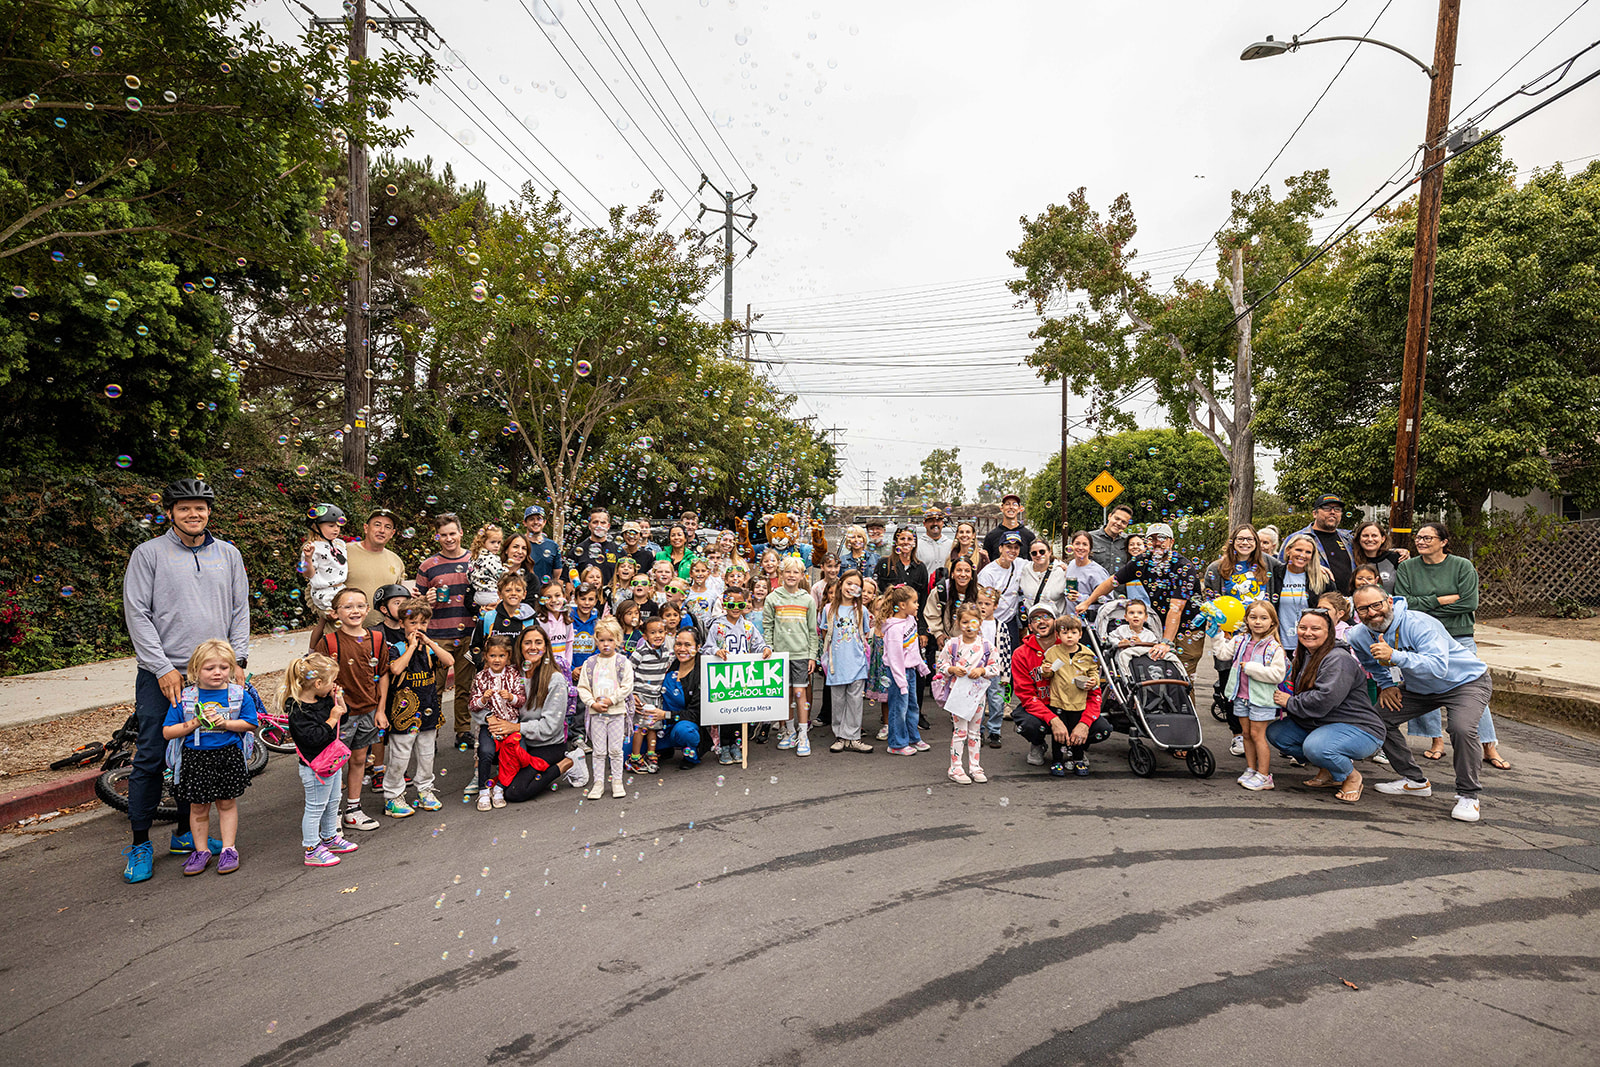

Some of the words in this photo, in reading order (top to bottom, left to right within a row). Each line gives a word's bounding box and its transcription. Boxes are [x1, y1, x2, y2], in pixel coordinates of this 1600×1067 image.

[1095, 484, 1114, 493] END
[709, 662, 783, 689] WALK
[713, 691, 725, 699] TO
[728, 688, 764, 698] SCHOOL
[766, 687, 782, 696] DAY
